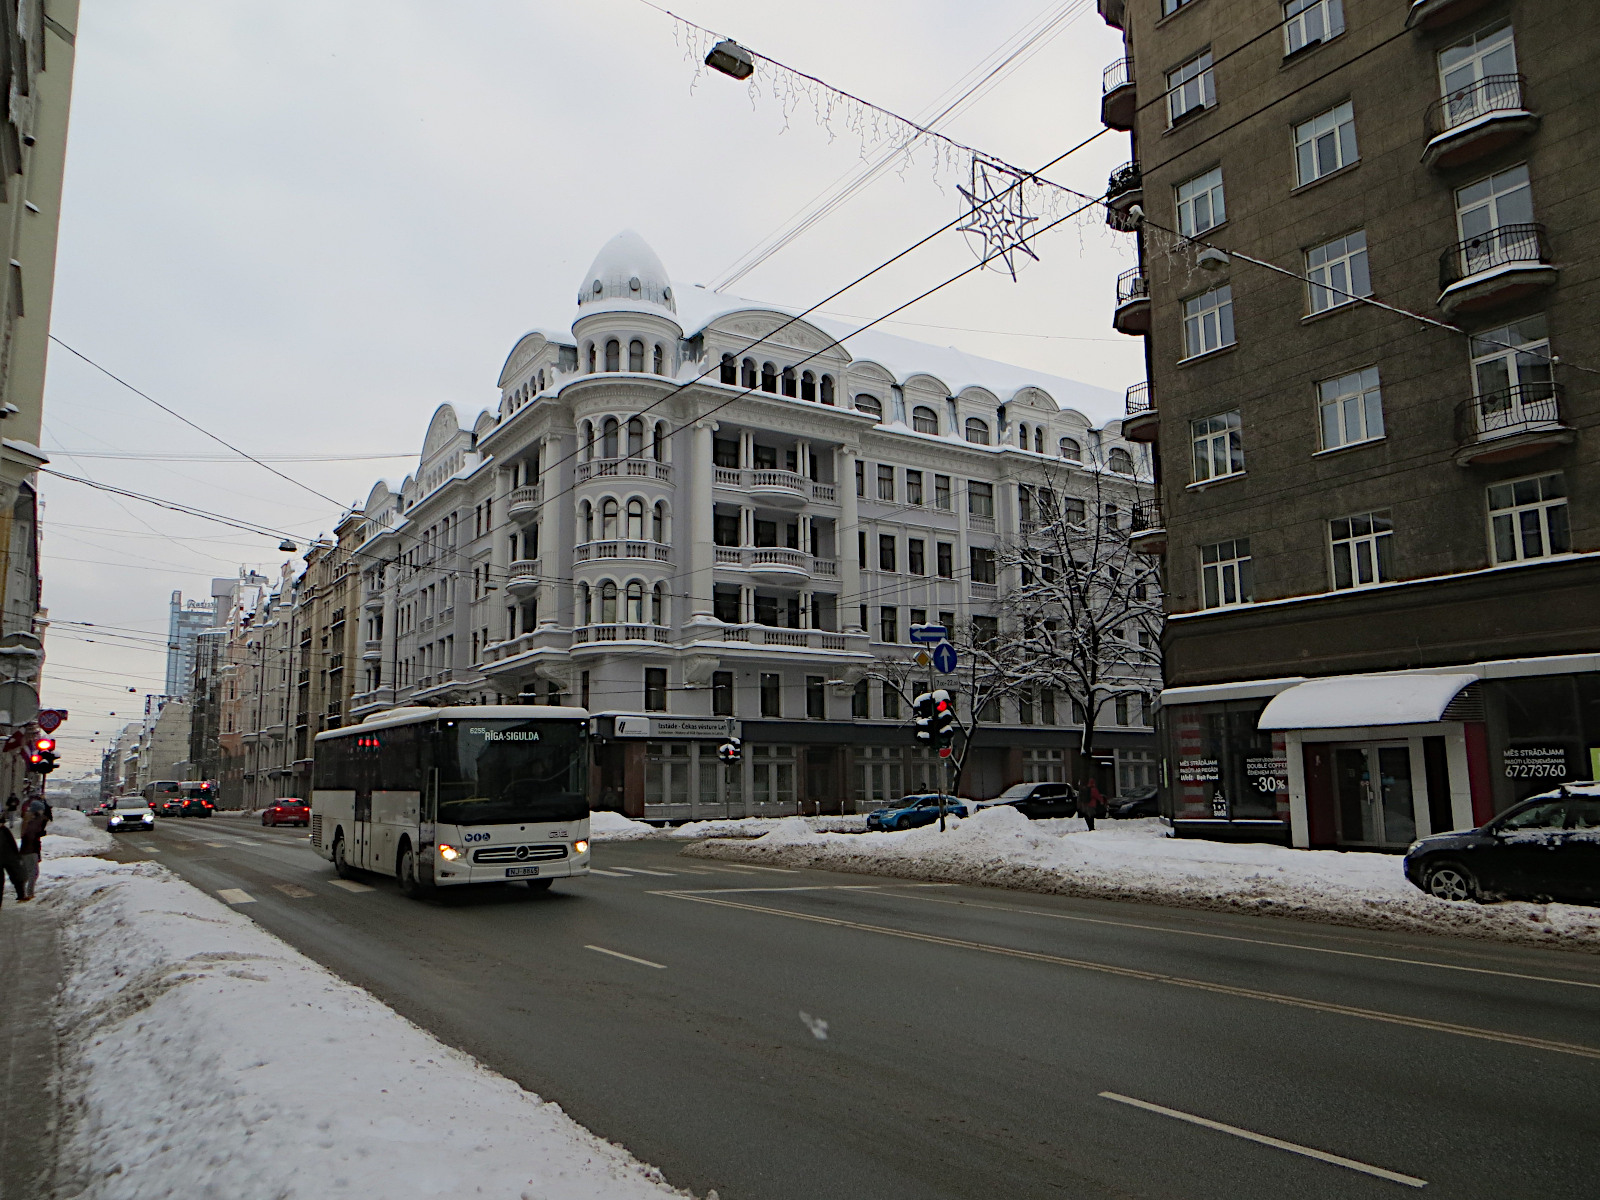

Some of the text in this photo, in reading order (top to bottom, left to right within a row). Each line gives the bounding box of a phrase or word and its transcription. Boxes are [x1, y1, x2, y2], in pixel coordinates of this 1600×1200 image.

[485, 730, 539, 741] RĪGA-SIGULDA
[1504, 749, 1519, 757] MĒS
[1505, 764, 1566, 777] 67273760
